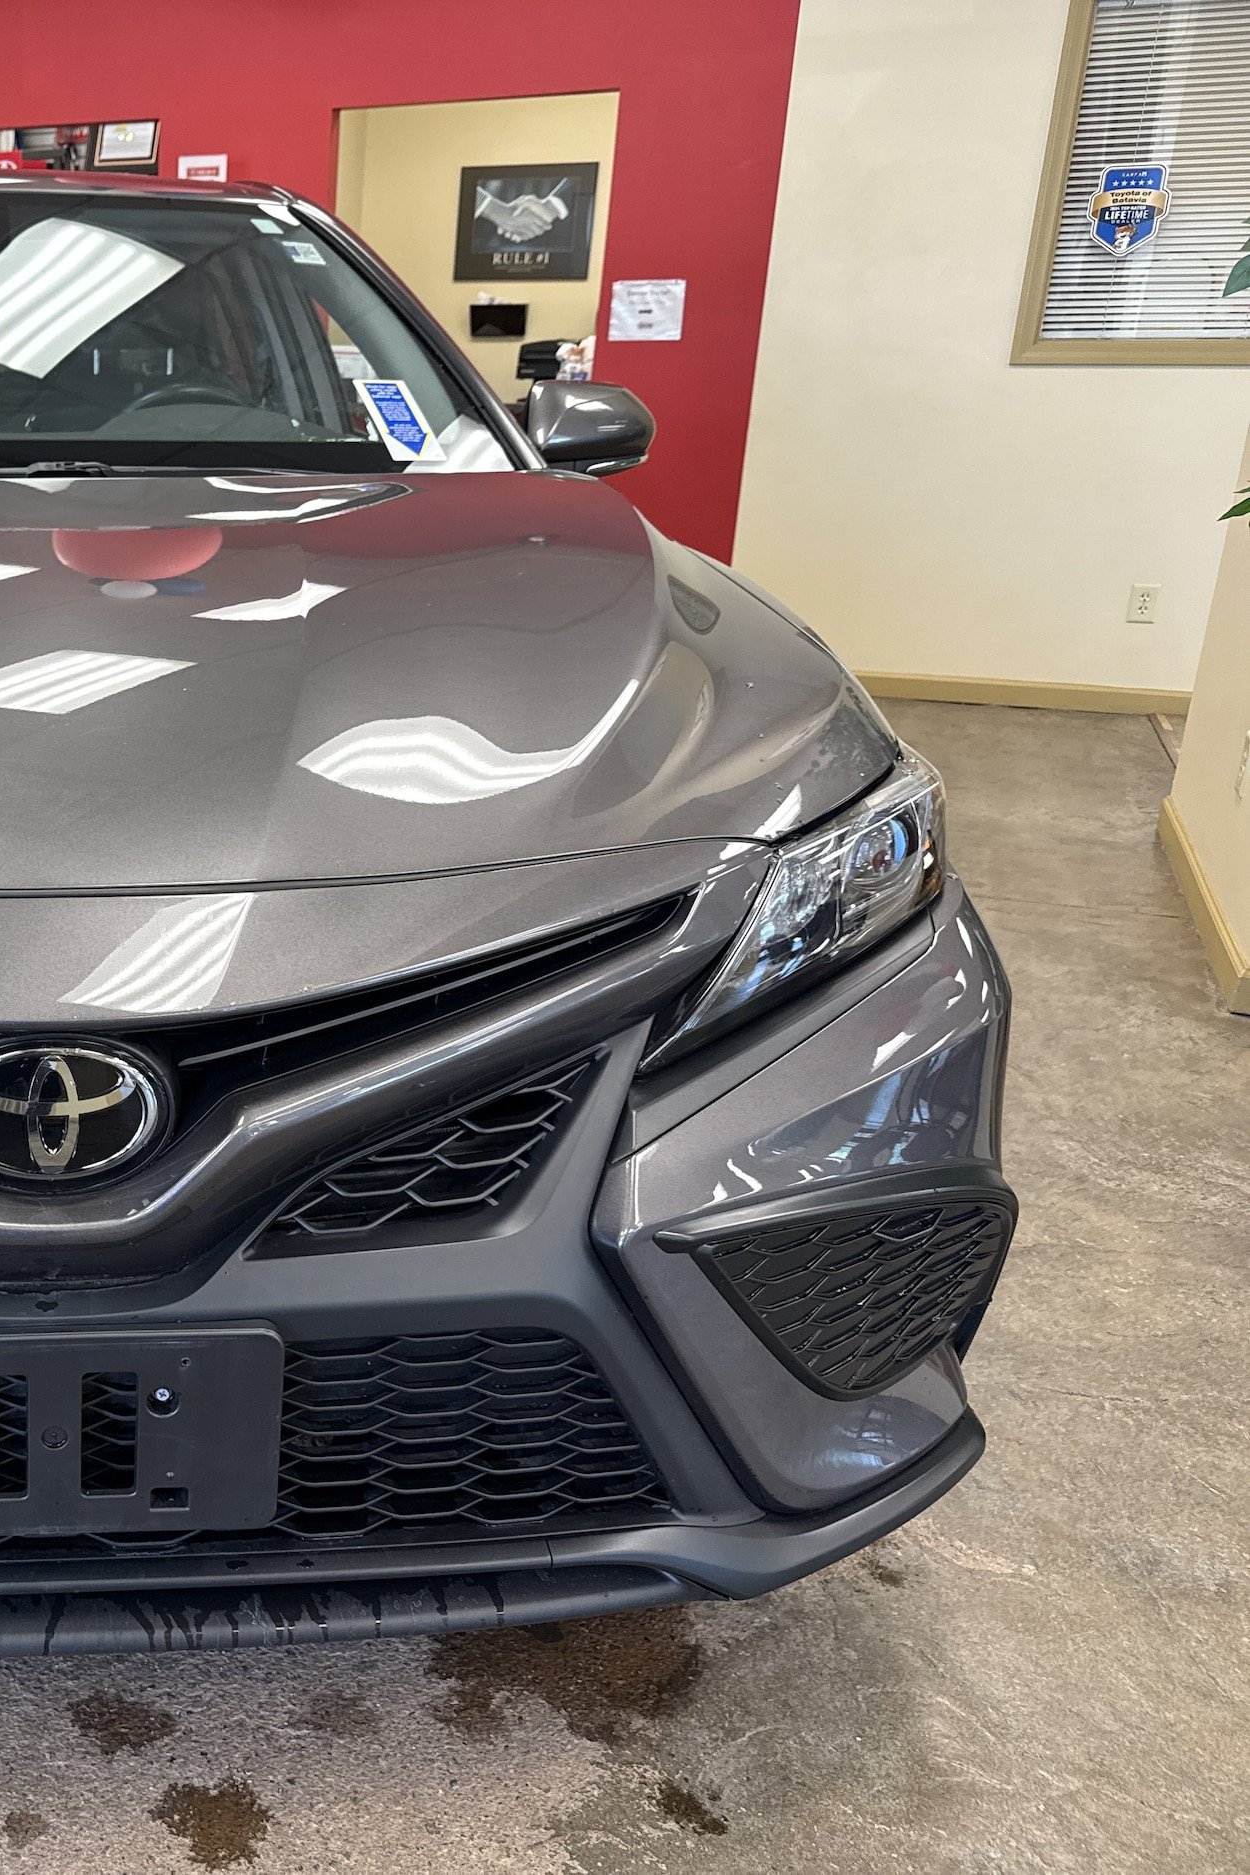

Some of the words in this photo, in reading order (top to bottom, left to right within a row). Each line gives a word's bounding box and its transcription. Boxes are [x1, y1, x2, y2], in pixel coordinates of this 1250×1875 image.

[1104, 210, 1149, 220] LIFETIME
[492, 252, 534, 265] RULE
[536, 252, 550, 264] #1
